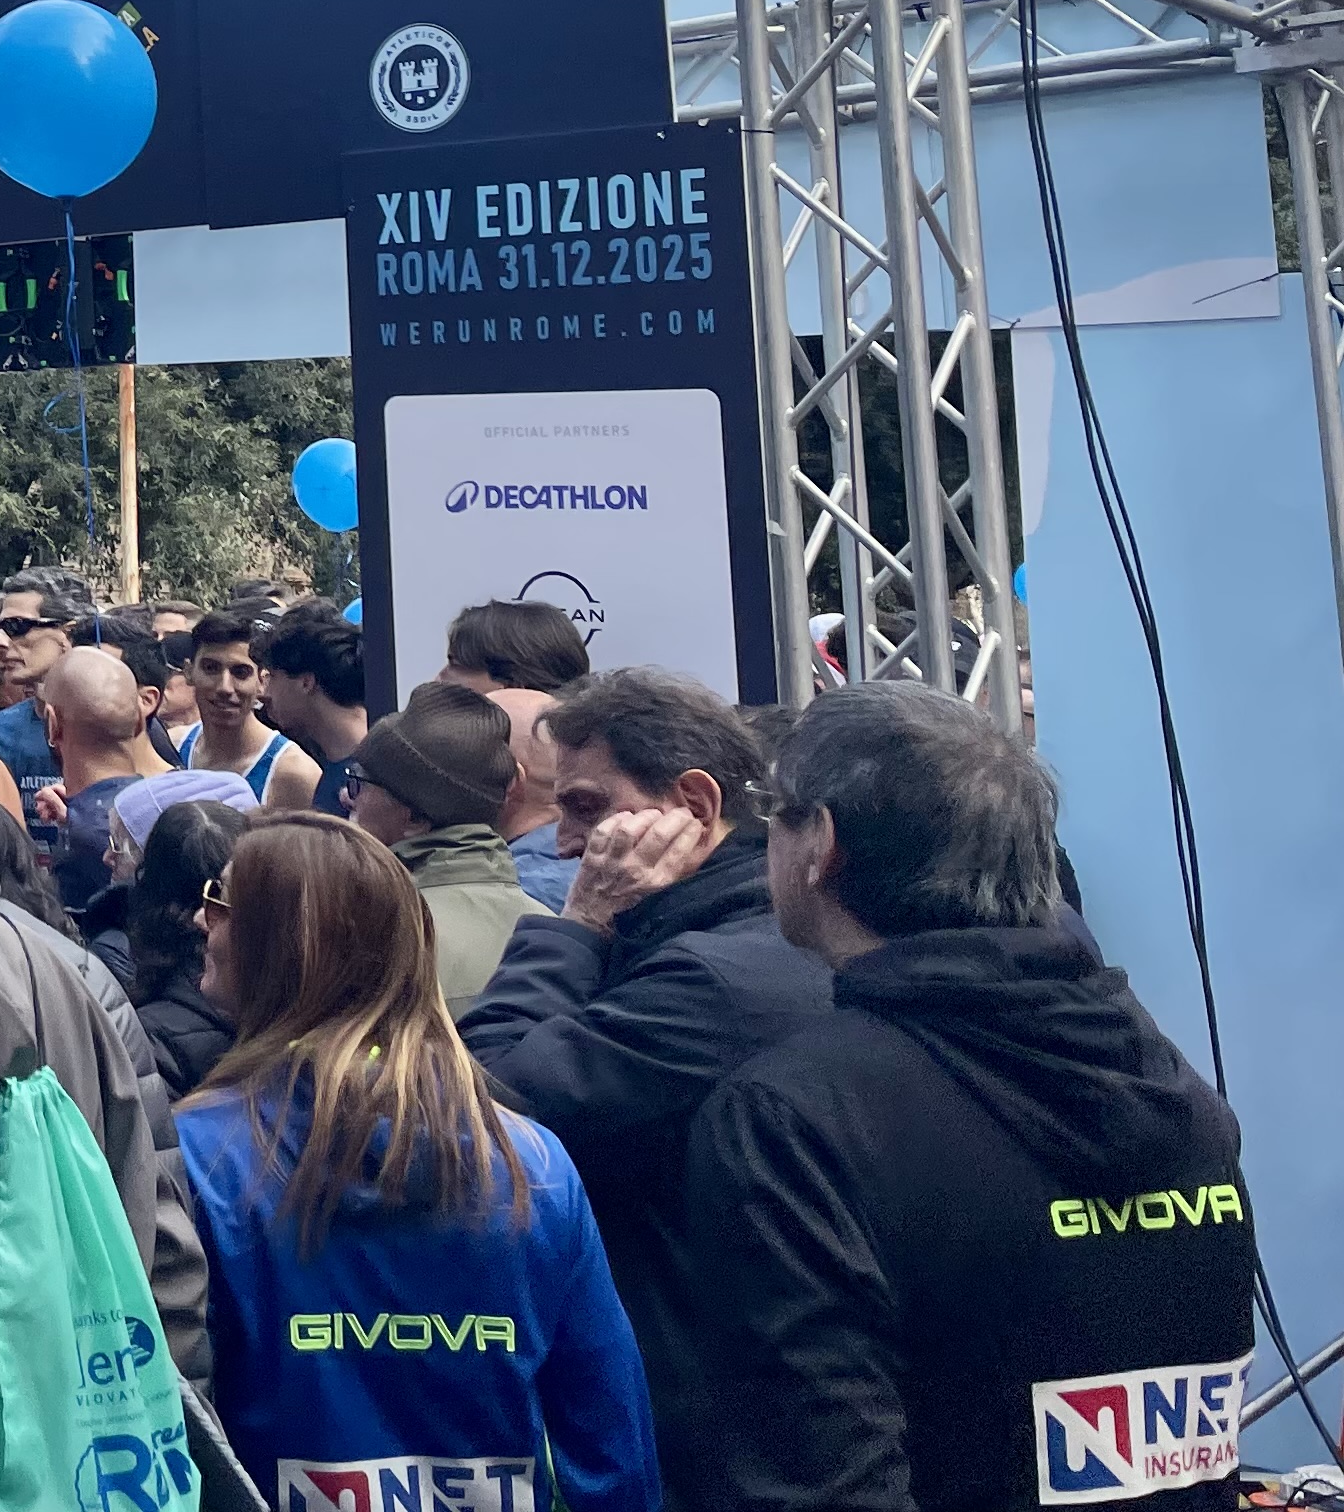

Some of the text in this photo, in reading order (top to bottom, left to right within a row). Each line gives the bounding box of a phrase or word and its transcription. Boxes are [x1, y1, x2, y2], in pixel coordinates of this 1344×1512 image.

[386, 31, 452, 57] ATLETICOM
[377, 168, 709, 245] XIV EDIZIONE
[377, 232, 713, 296] ROMA 31.12.2025
[379, 308, 716, 347] WERUNROME.COM
[483, 424, 631, 438] OFFICIAL PARTNERS
[485, 485, 648, 511] DECATHLON
[1050, 1185, 1244, 1238] GIVOVA
[289, 1313, 515, 1352] GIVOVA
